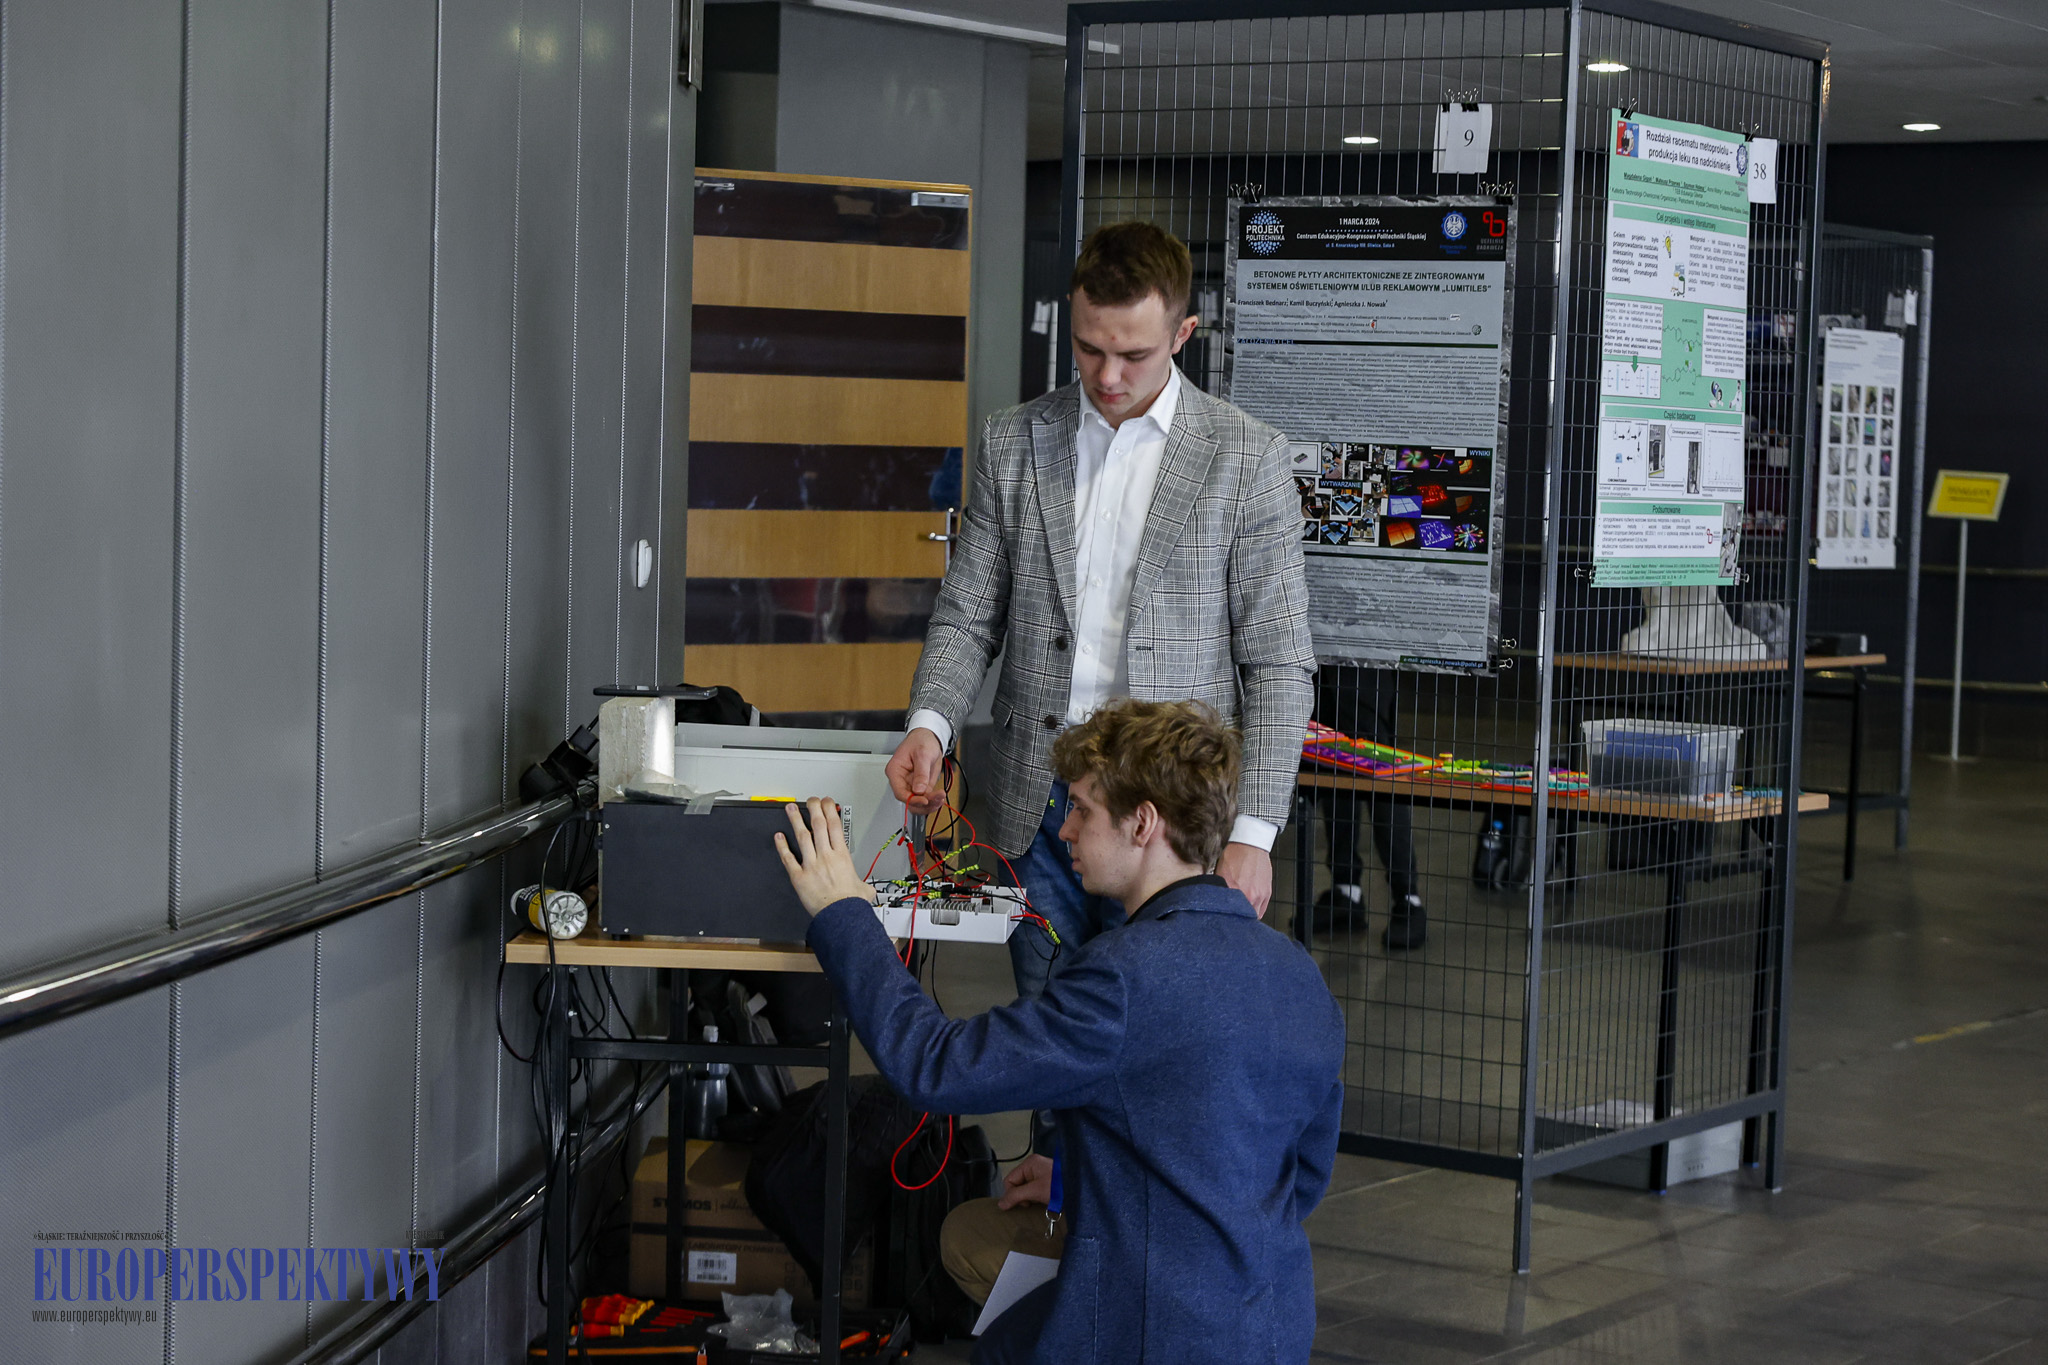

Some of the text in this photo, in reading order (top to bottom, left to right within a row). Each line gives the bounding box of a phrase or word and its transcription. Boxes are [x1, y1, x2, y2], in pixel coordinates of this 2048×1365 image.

[1464, 130, 1474, 147] 9
[1646, 130, 1672, 144] Rozdział
[1672, 136, 1698, 149] racematu
[1700, 141, 1729, 156] metoprololu
[1648, 148, 1678, 163] produkcja
[1679, 152, 1690, 164] leku
[1700, 156, 1731, 172] nadciśnienie
[1753, 162, 1767, 180] 38
[1343, 218, 1364, 226] MARCA
[1365, 218, 1380, 226] 2024
[1246, 224, 1285, 234] PROJEKT
[1407, 232, 1427, 241] Śląskiej
[1254, 270, 1296, 278] BETONOWE
[1298, 271, 1322, 279] PŁYTY
[1323, 271, 1400, 280] ARCHITEKTONICZNE
[1414, 272, 1485, 280] ZINTEGROWANYM
[1290, 281, 1360, 291] OŚWIETLENIOWYM
[1320, 480, 1362, 488] WYTWARZANIE
[844, 808, 851, 816] DC
